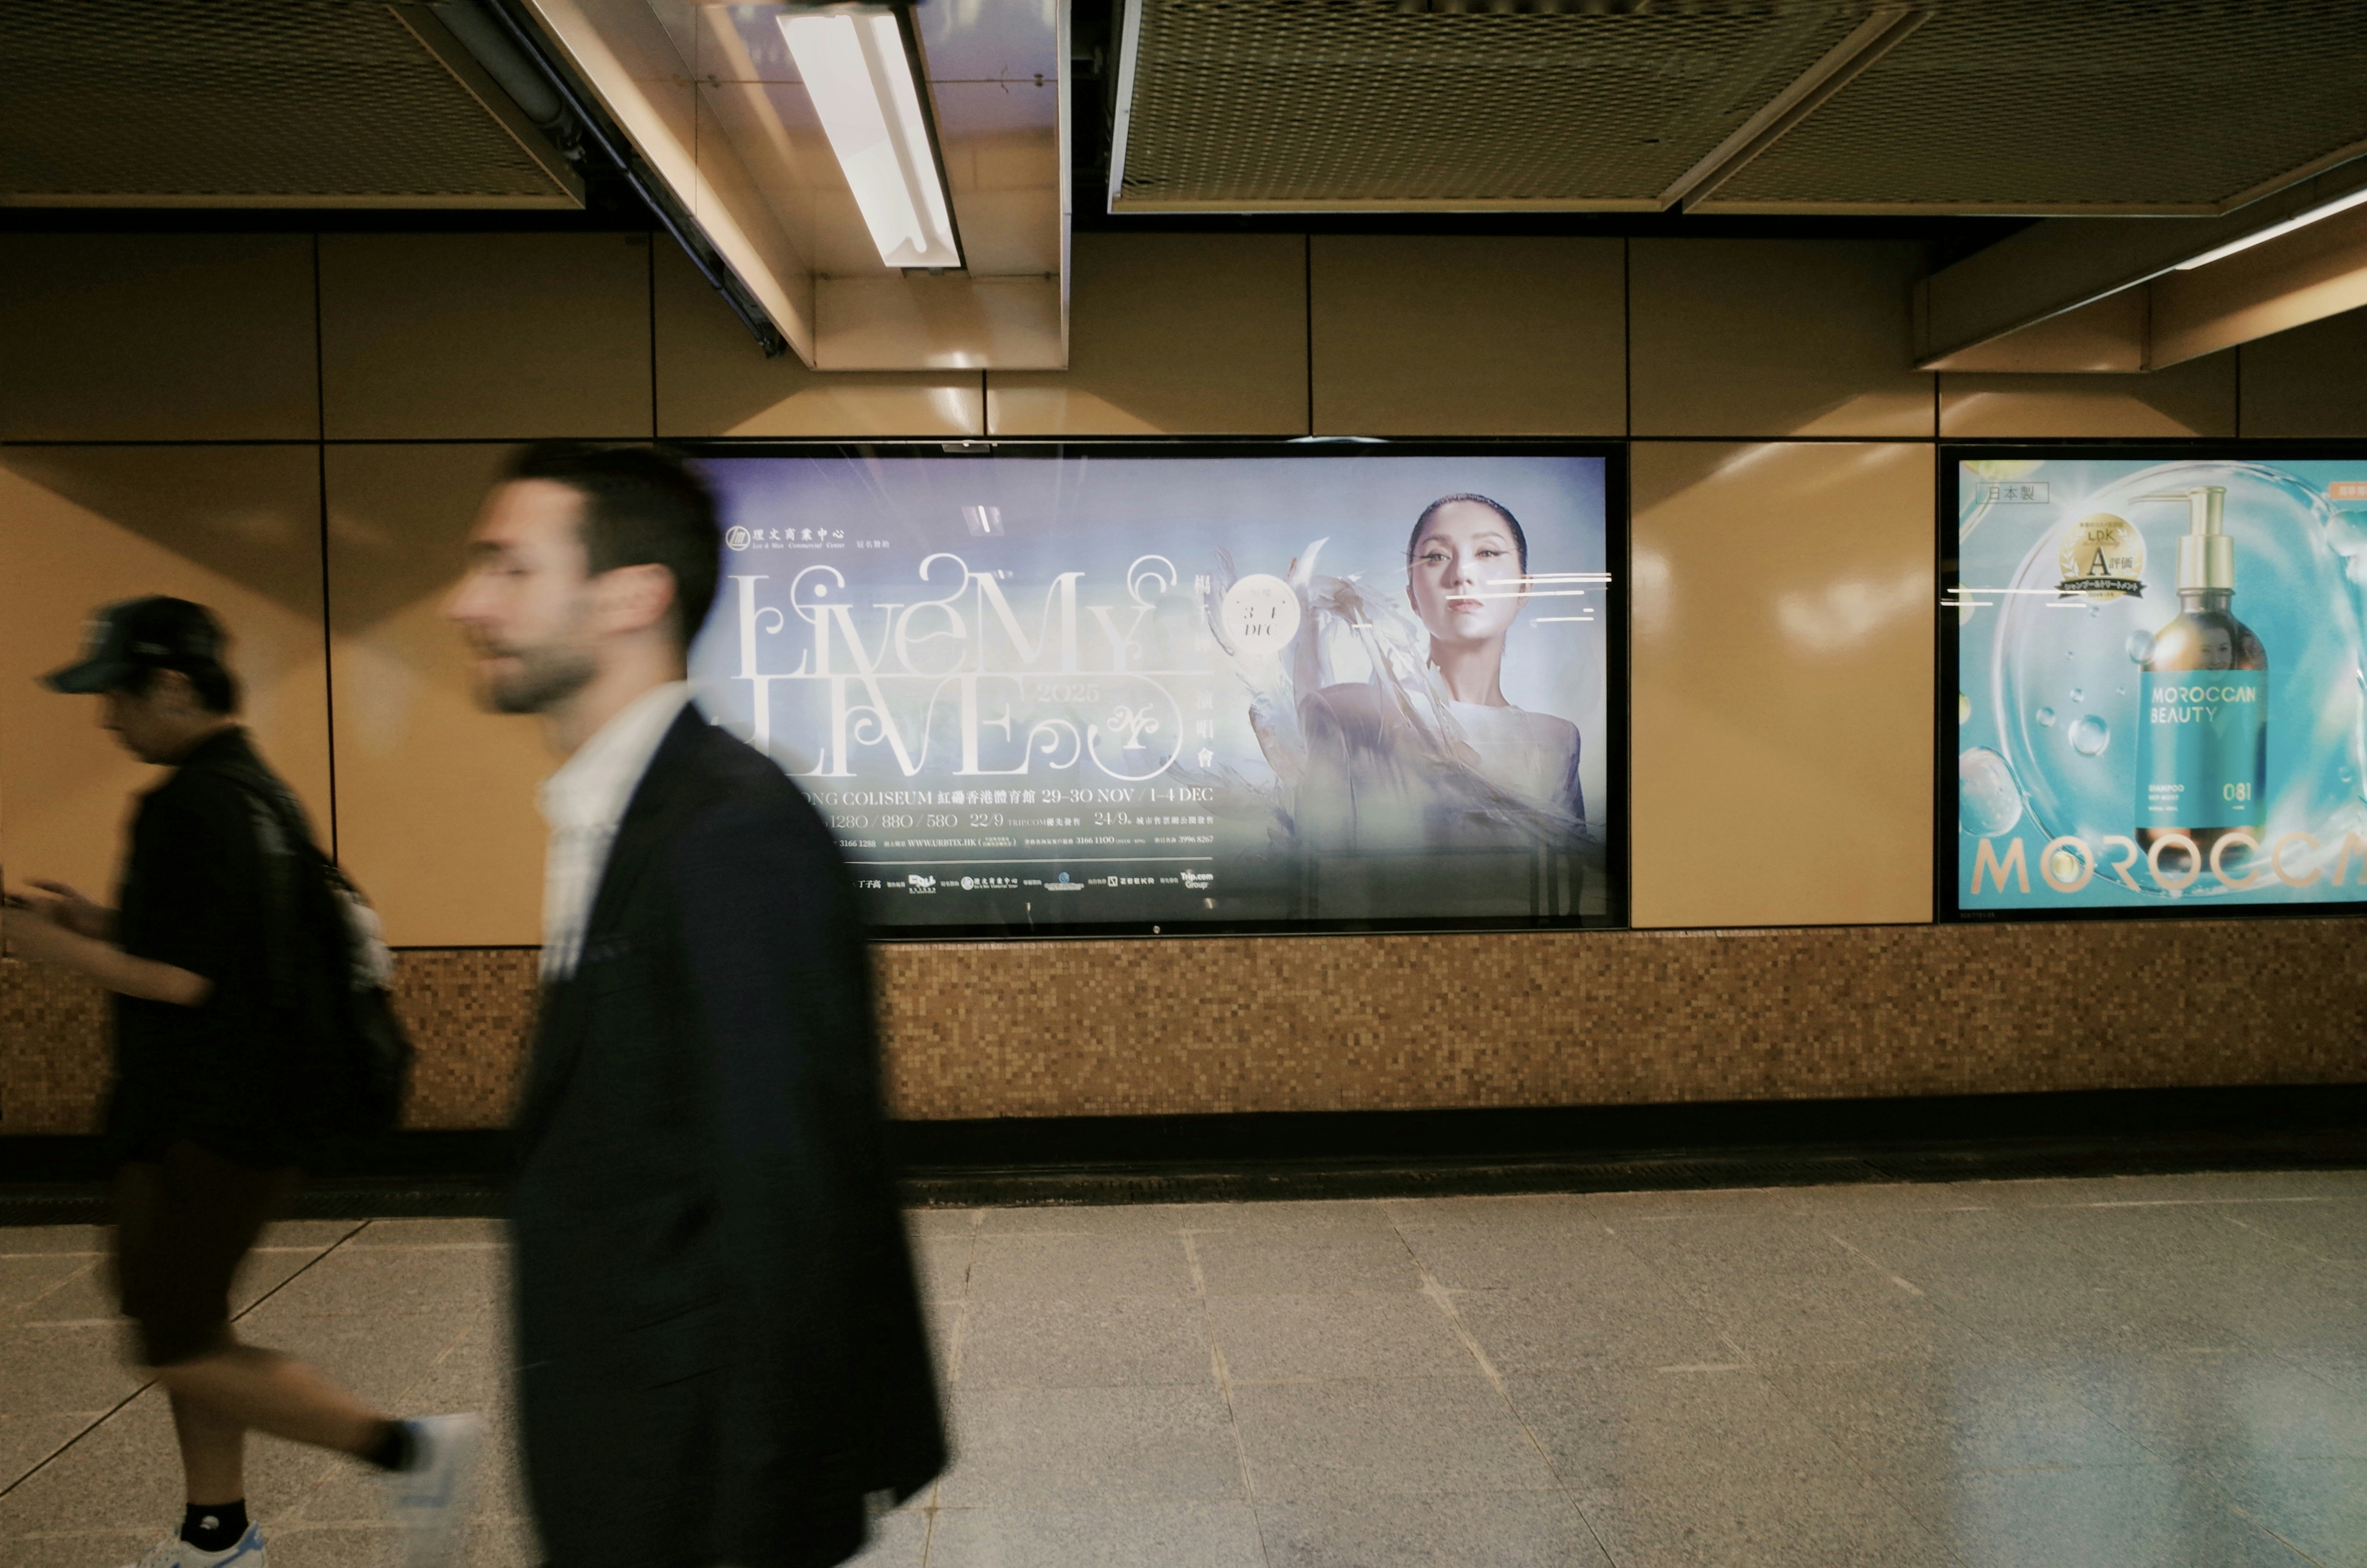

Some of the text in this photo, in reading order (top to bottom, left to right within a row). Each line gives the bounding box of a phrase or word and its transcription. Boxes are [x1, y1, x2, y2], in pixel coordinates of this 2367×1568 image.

[1989, 485, 2034, 501] 日本製
[752, 527, 844, 541] 理文商業中心
[2088, 528, 2116, 541] LDK
[1037, 683, 1100, 702] 2025
[2152, 686, 2256, 703] MOROCCAN
[2151, 706, 2217, 723] BEAUTY
[842, 791, 932, 806] COLISEUM
[1097, 788, 1134, 803] NOV
[1180, 787, 1213, 802] DEC
[2223, 782, 2252, 802] 081
[830, 815, 868, 829] 1280
[882, 814, 913, 828] 880
[927, 814, 957, 828] 580
[970, 813, 1004, 828] 22/9
[840, 839, 858, 847] 3166
[859, 839, 876, 847] 1288
[1095, 836, 1115, 844] 1100
[1180, 872, 1213, 881] Trip.com
[1185, 880, 1209, 890] Group
